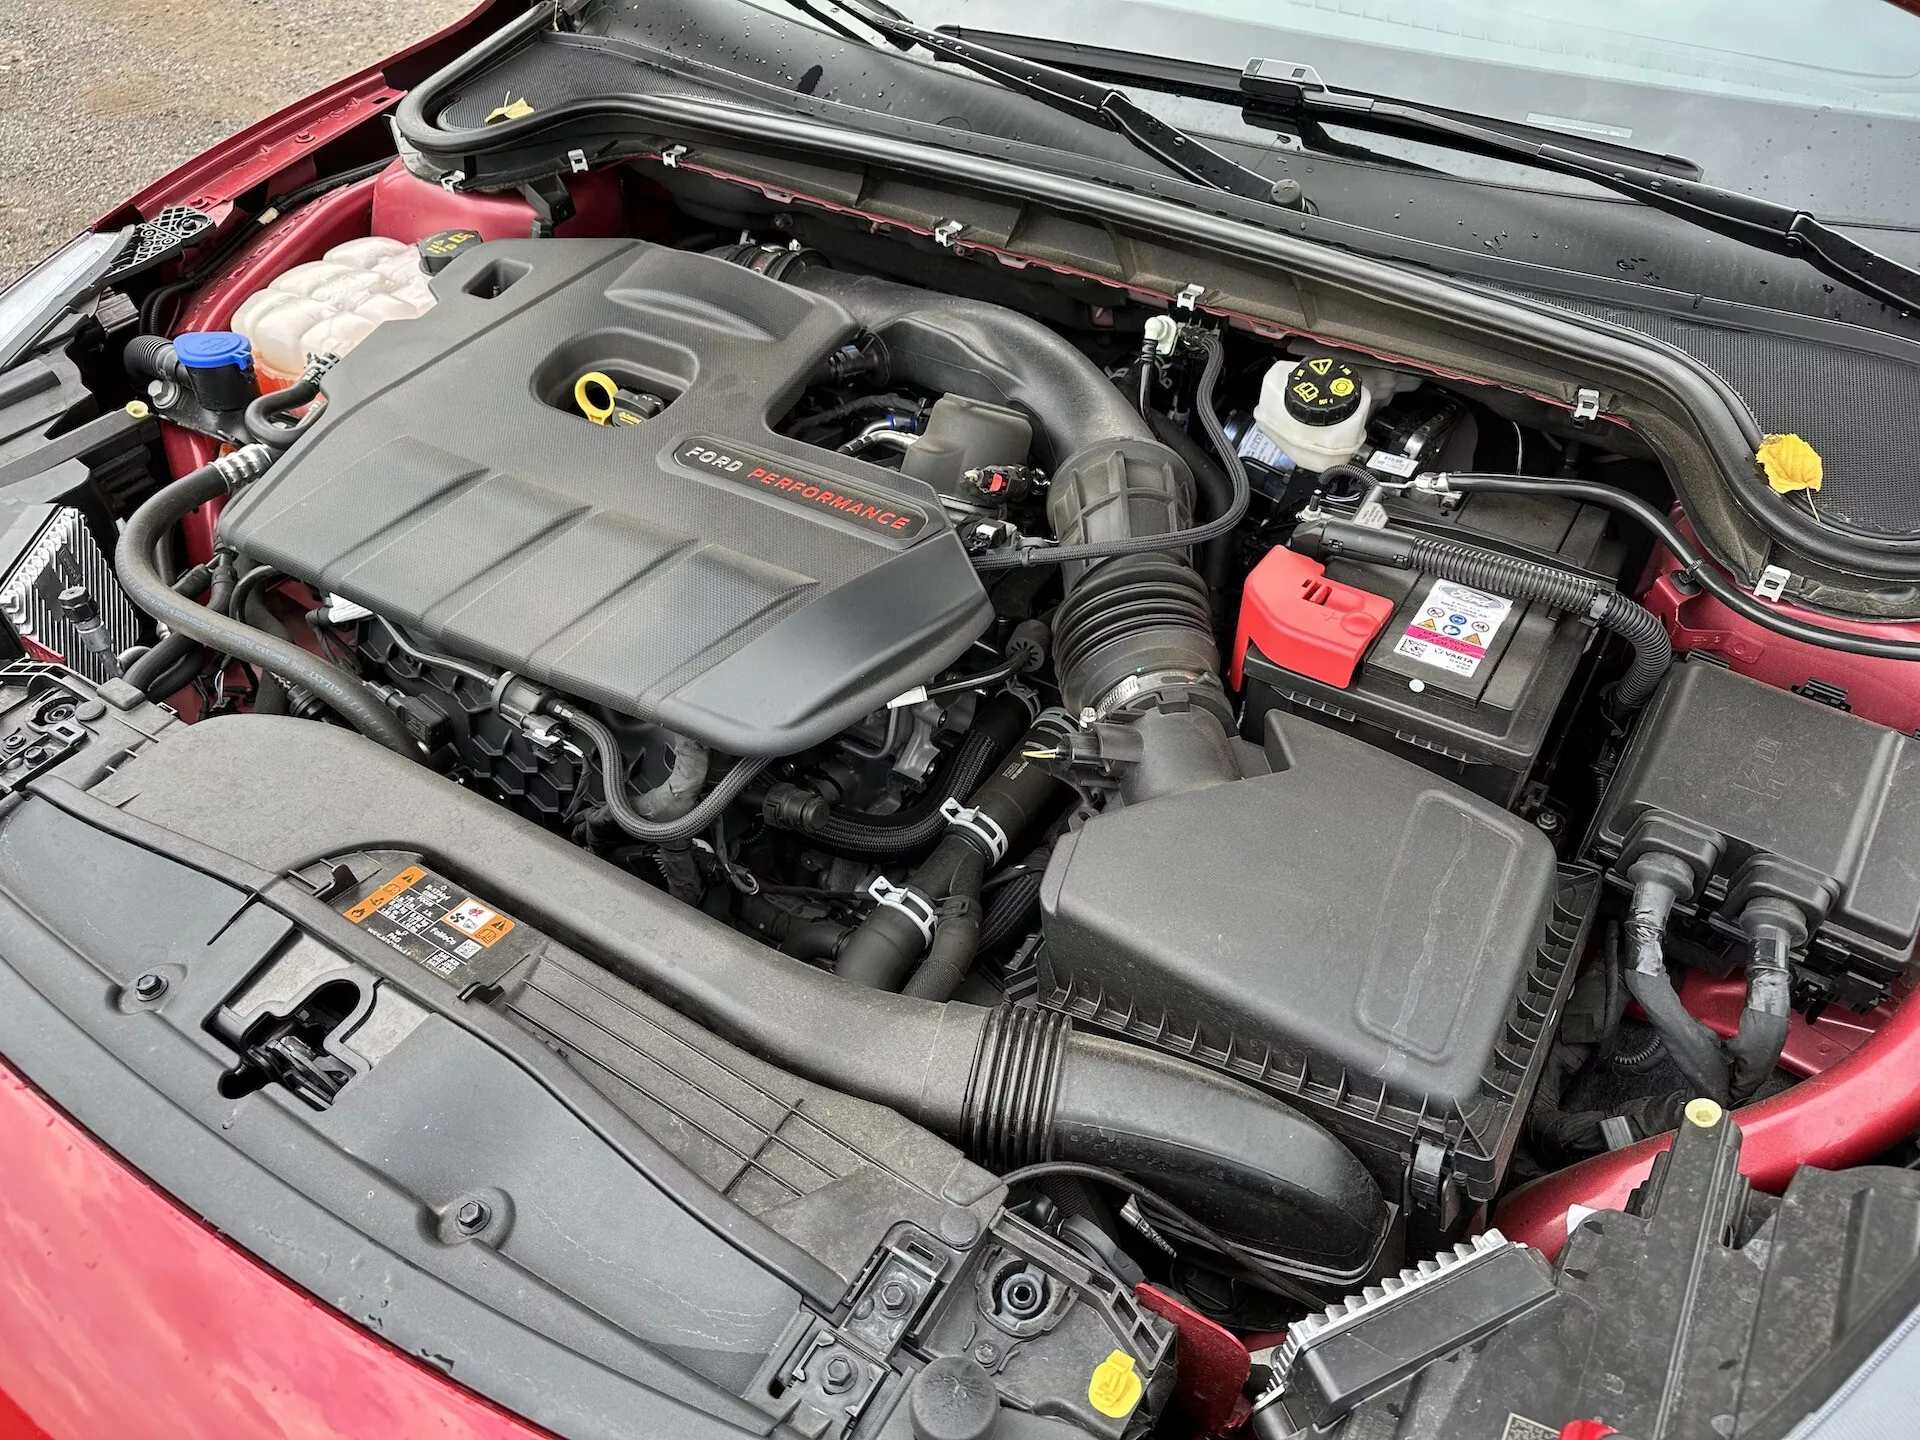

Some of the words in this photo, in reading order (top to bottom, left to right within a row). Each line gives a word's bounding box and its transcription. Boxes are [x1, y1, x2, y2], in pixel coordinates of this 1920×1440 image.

[685, 446, 744, 472] FORD
[747, 467, 911, 530] PERFORMANCE
[1450, 588, 1493, 608] Ford
[1444, 651, 1474, 664] VARTA
[309, 671, 343, 696] GALAXY
[416, 896, 434, 907] FOCUS
[386, 932, 402, 943] PAG
[429, 927, 457, 945] FoMoCo
